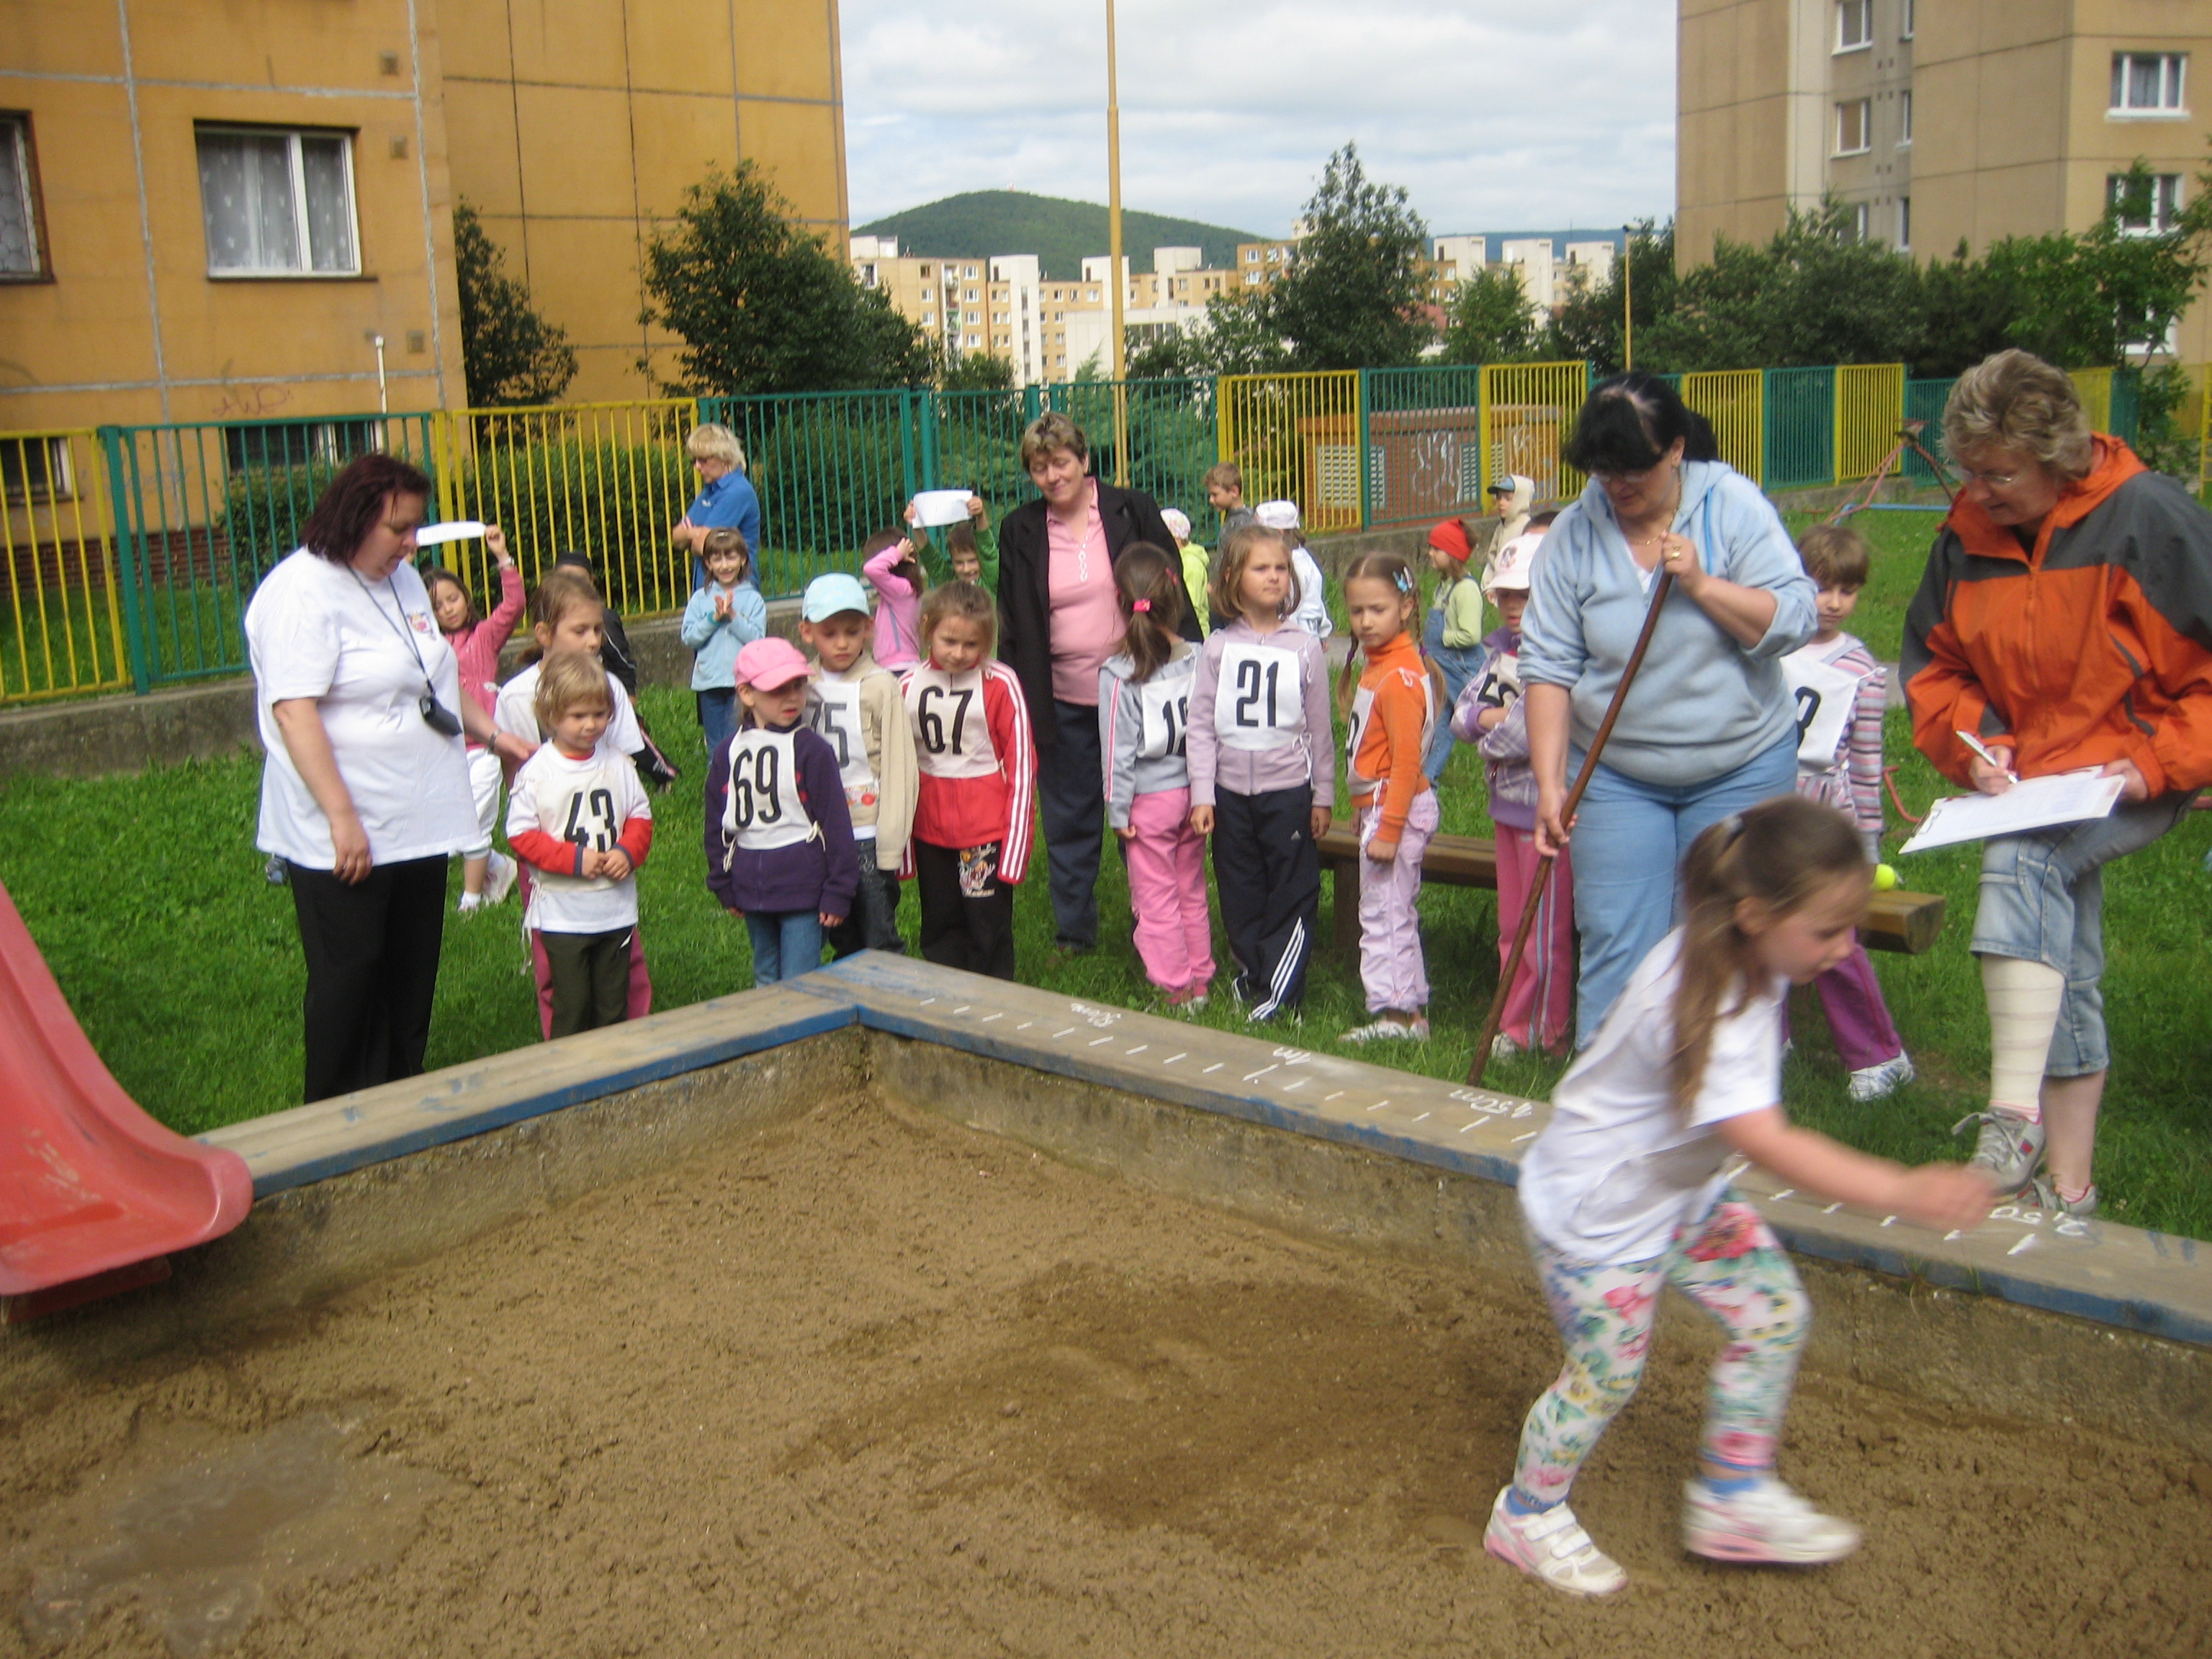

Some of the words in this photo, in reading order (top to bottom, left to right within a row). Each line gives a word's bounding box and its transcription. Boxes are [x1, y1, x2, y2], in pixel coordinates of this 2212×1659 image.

[918, 685, 974, 755] 67
[1236, 660, 1279, 727] 21
[806, 701, 850, 768] 75
[733, 745, 781, 827] 69
[564, 788, 617, 853] 43
